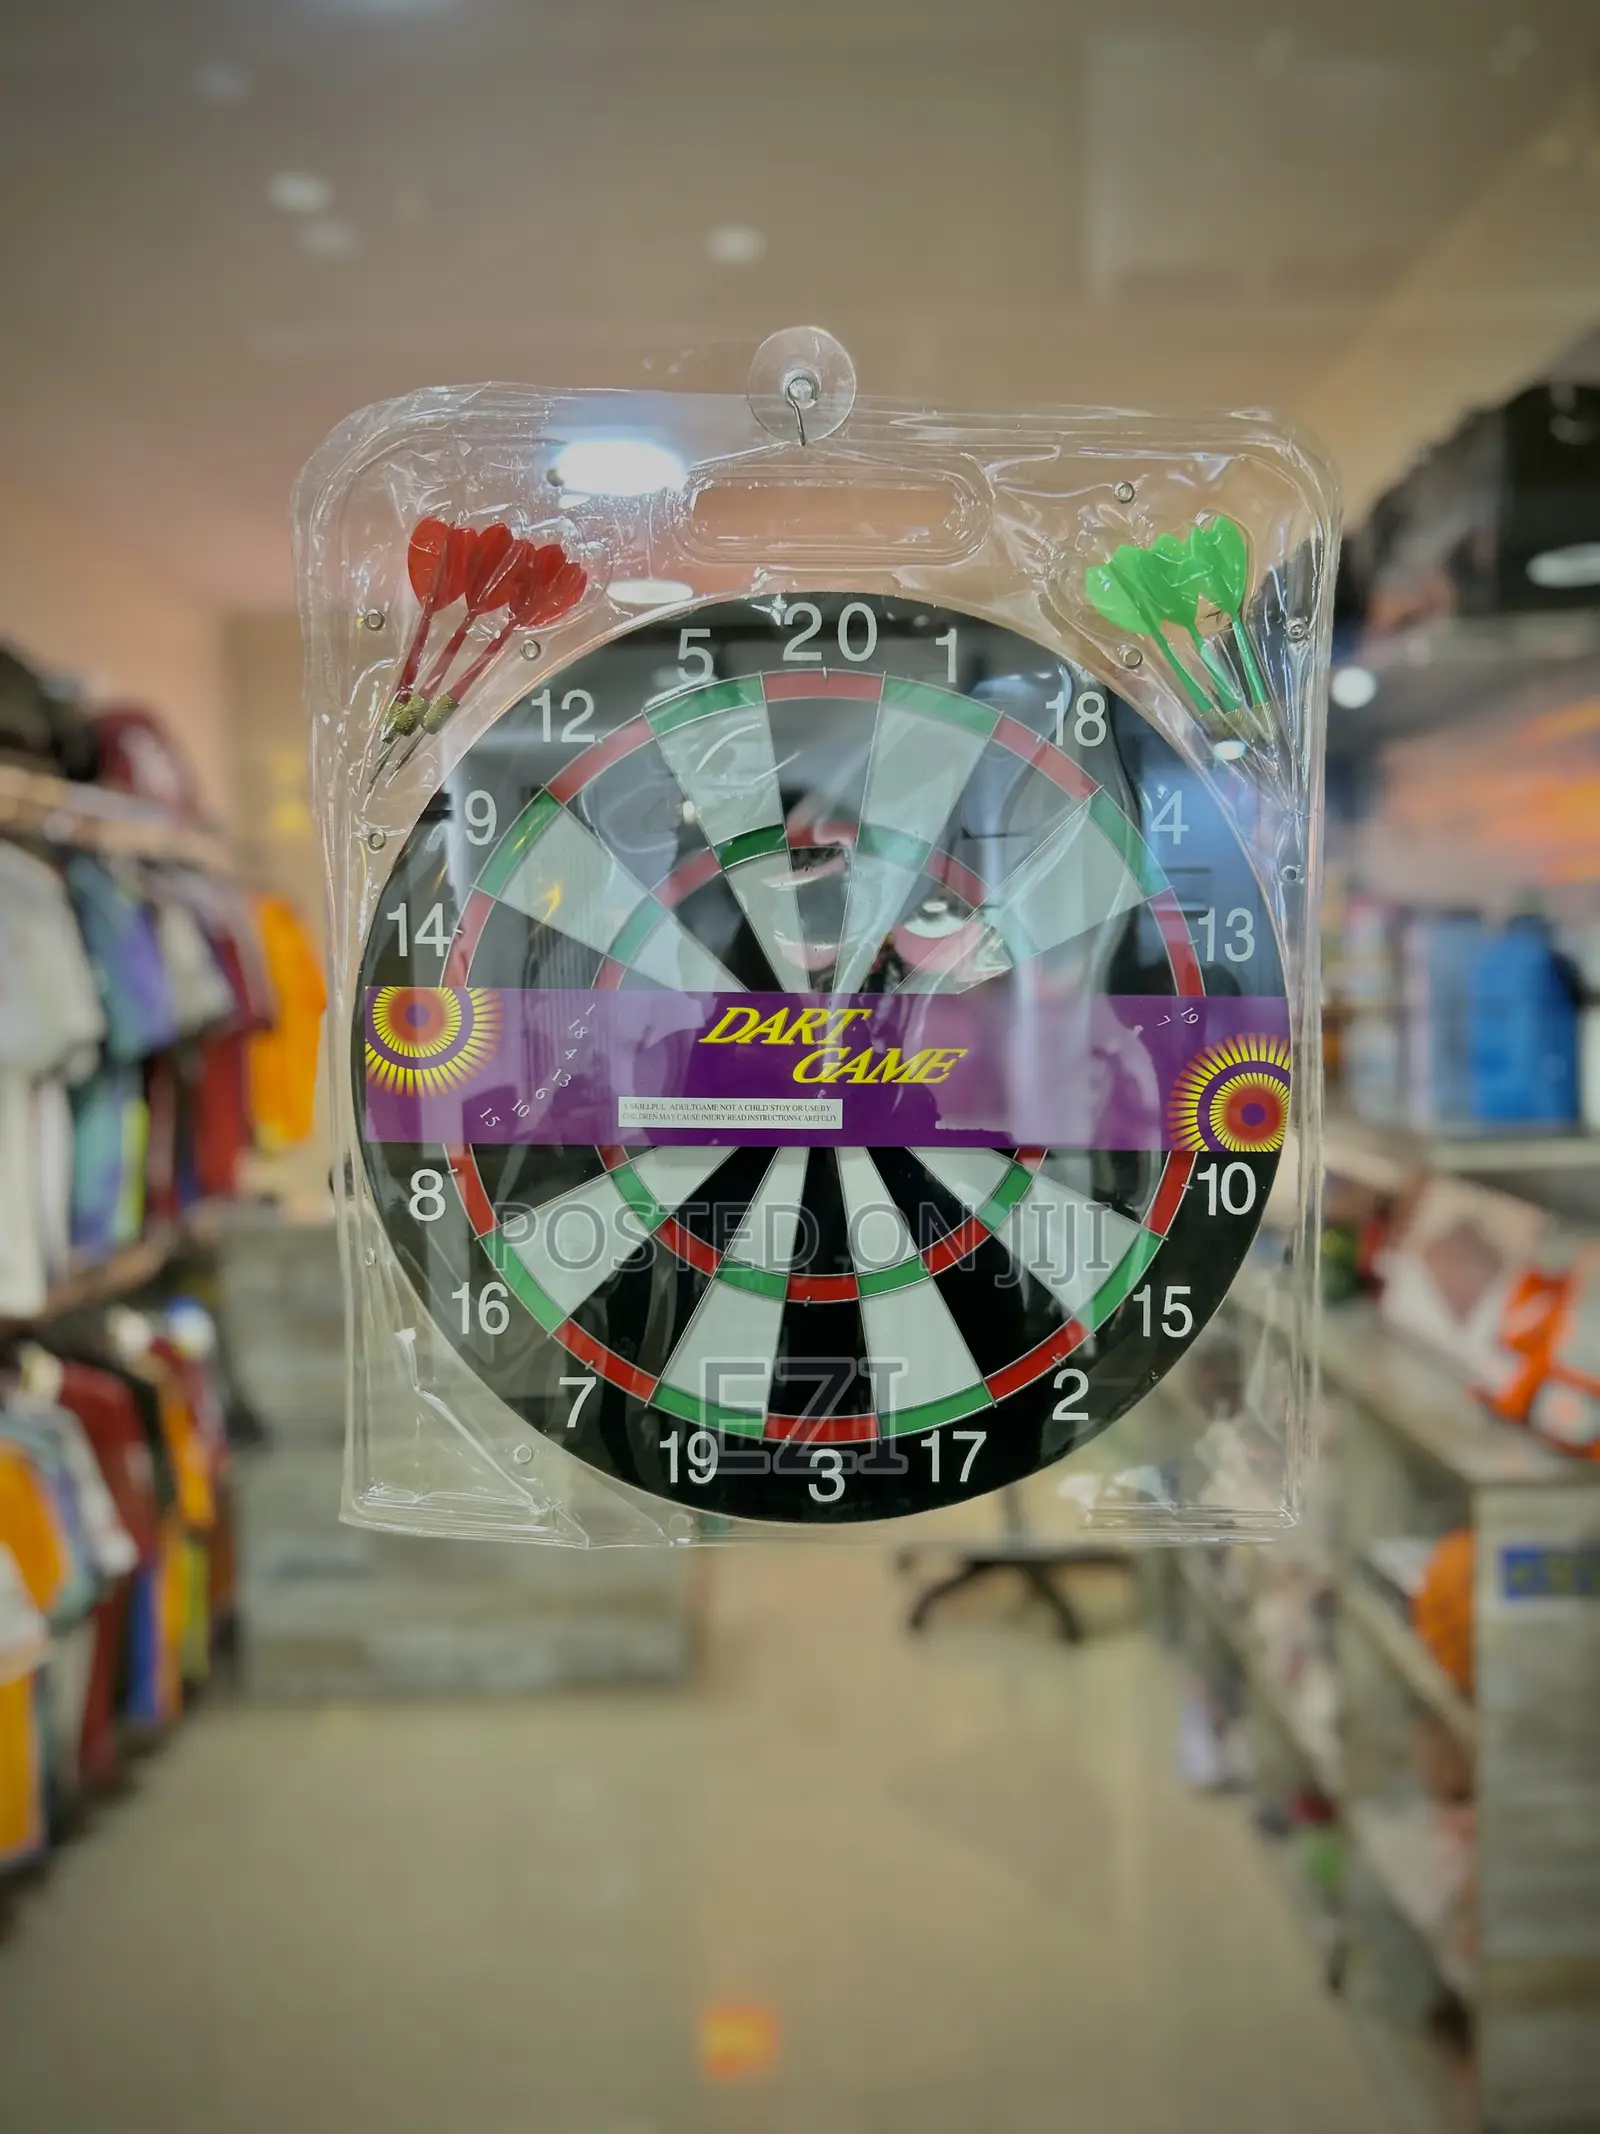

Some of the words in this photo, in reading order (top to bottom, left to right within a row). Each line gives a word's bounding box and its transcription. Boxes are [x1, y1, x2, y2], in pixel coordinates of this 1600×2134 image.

[677, 628, 714, 686] 5
[783, 602, 877, 662] 20
[935, 627, 957, 683] 1
[531, 689, 596, 743] 12
[1045, 691, 1107, 747] 18
[464, 789, 497, 846] 9
[1150, 790, 1189, 844] 4
[386, 902, 452, 957] 14
[1197, 907, 1256, 963] 13
[568, 1018, 588, 1040] 18
[698, 1006, 872, 1044] DART
[1180, 1007, 1199, 1025] 19
[551, 1068, 572, 1088] 13
[792, 1048, 968, 1084] GAME
[480, 1107, 501, 1127] 15
[511, 1099, 531, 1118] 10
[676, 1113, 700, 1121] CAUSE
[701, 1113, 726, 1121] INJURY
[747, 1114, 798, 1122] INSTRUCTIONS
[409, 1169, 446, 1221] 8
[1197, 1162, 1256, 1216] 10
[452, 1281, 510, 1335] 16
[1133, 1285, 1193, 1338] 15
[559, 1377, 597, 1428] 7
[1052, 1368, 1089, 1421] 2
[659, 1430, 719, 1484] 19
[808, 1449, 846, 1502] 3
[921, 1430, 987, 1482] 17
